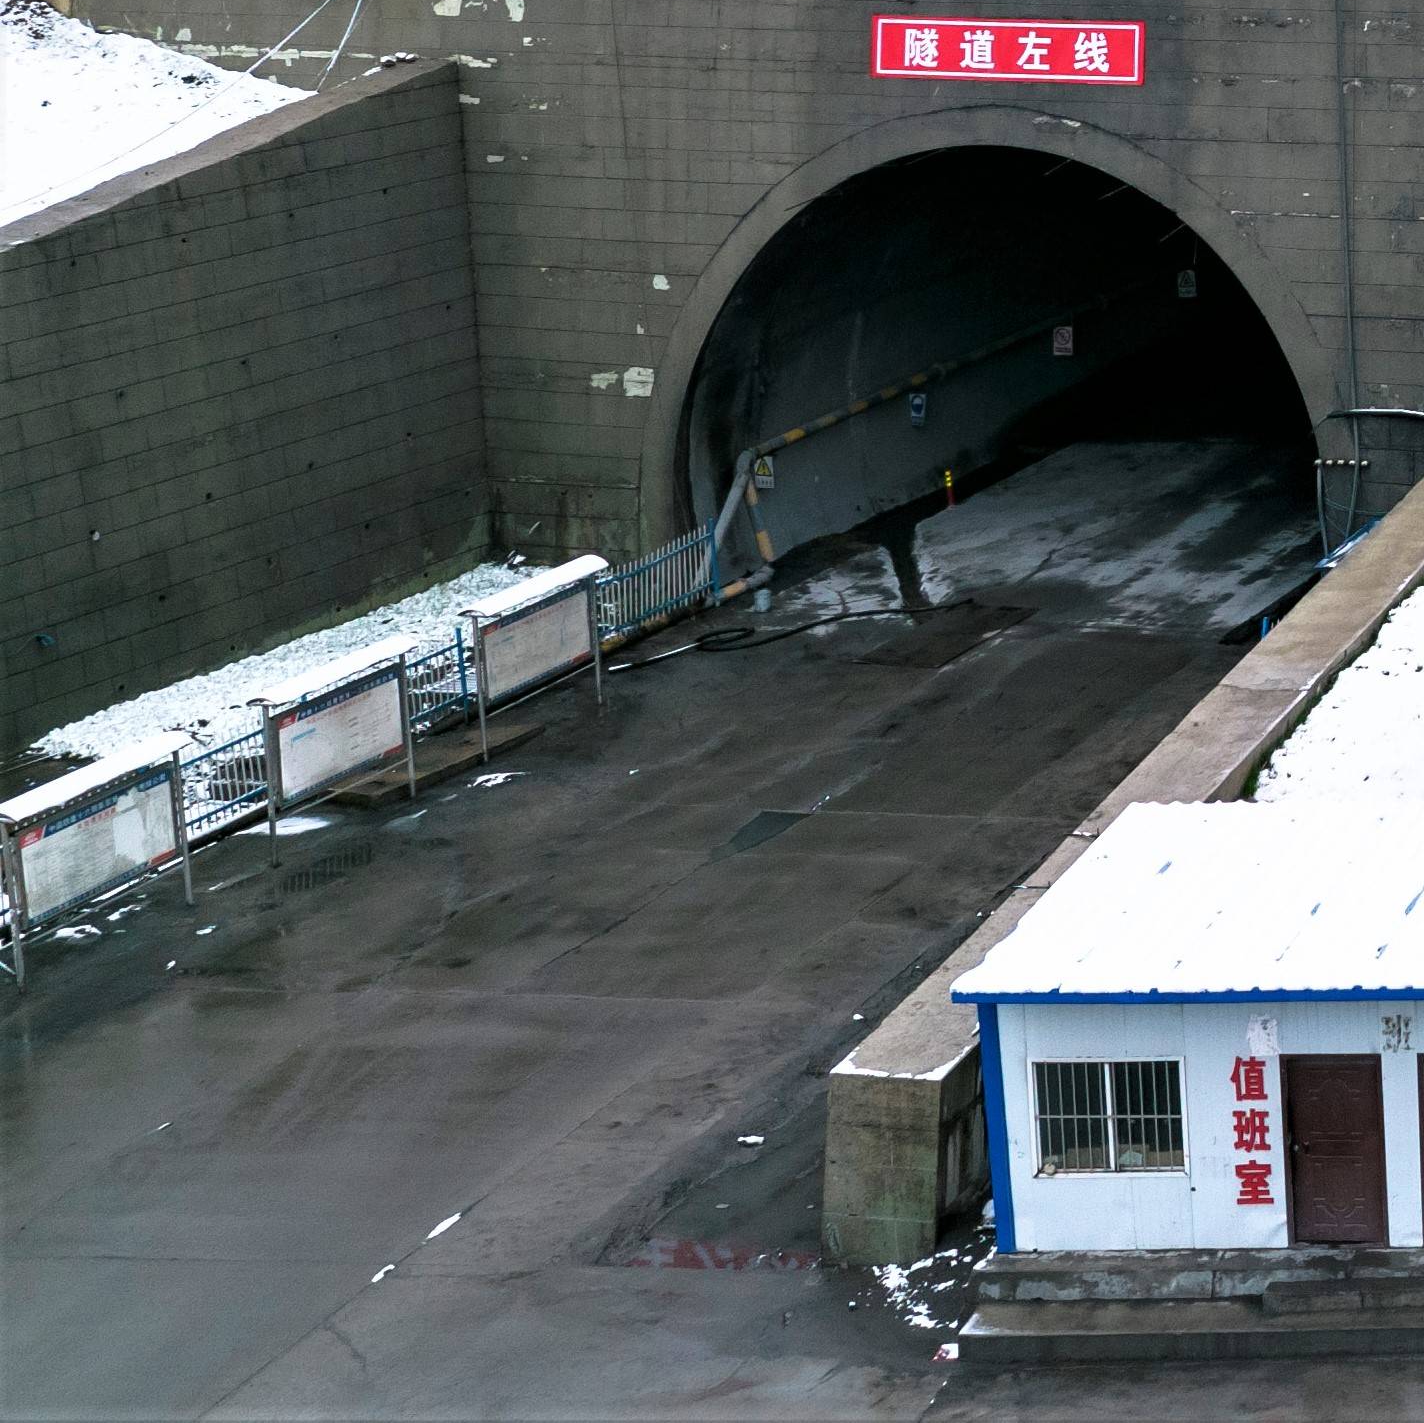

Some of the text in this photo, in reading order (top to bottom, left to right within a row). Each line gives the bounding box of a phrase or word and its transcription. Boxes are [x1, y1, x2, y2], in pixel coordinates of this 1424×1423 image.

[904, 28, 1110, 73] 隧道左线
[1230, 1055, 1275, 1206] 值班室
